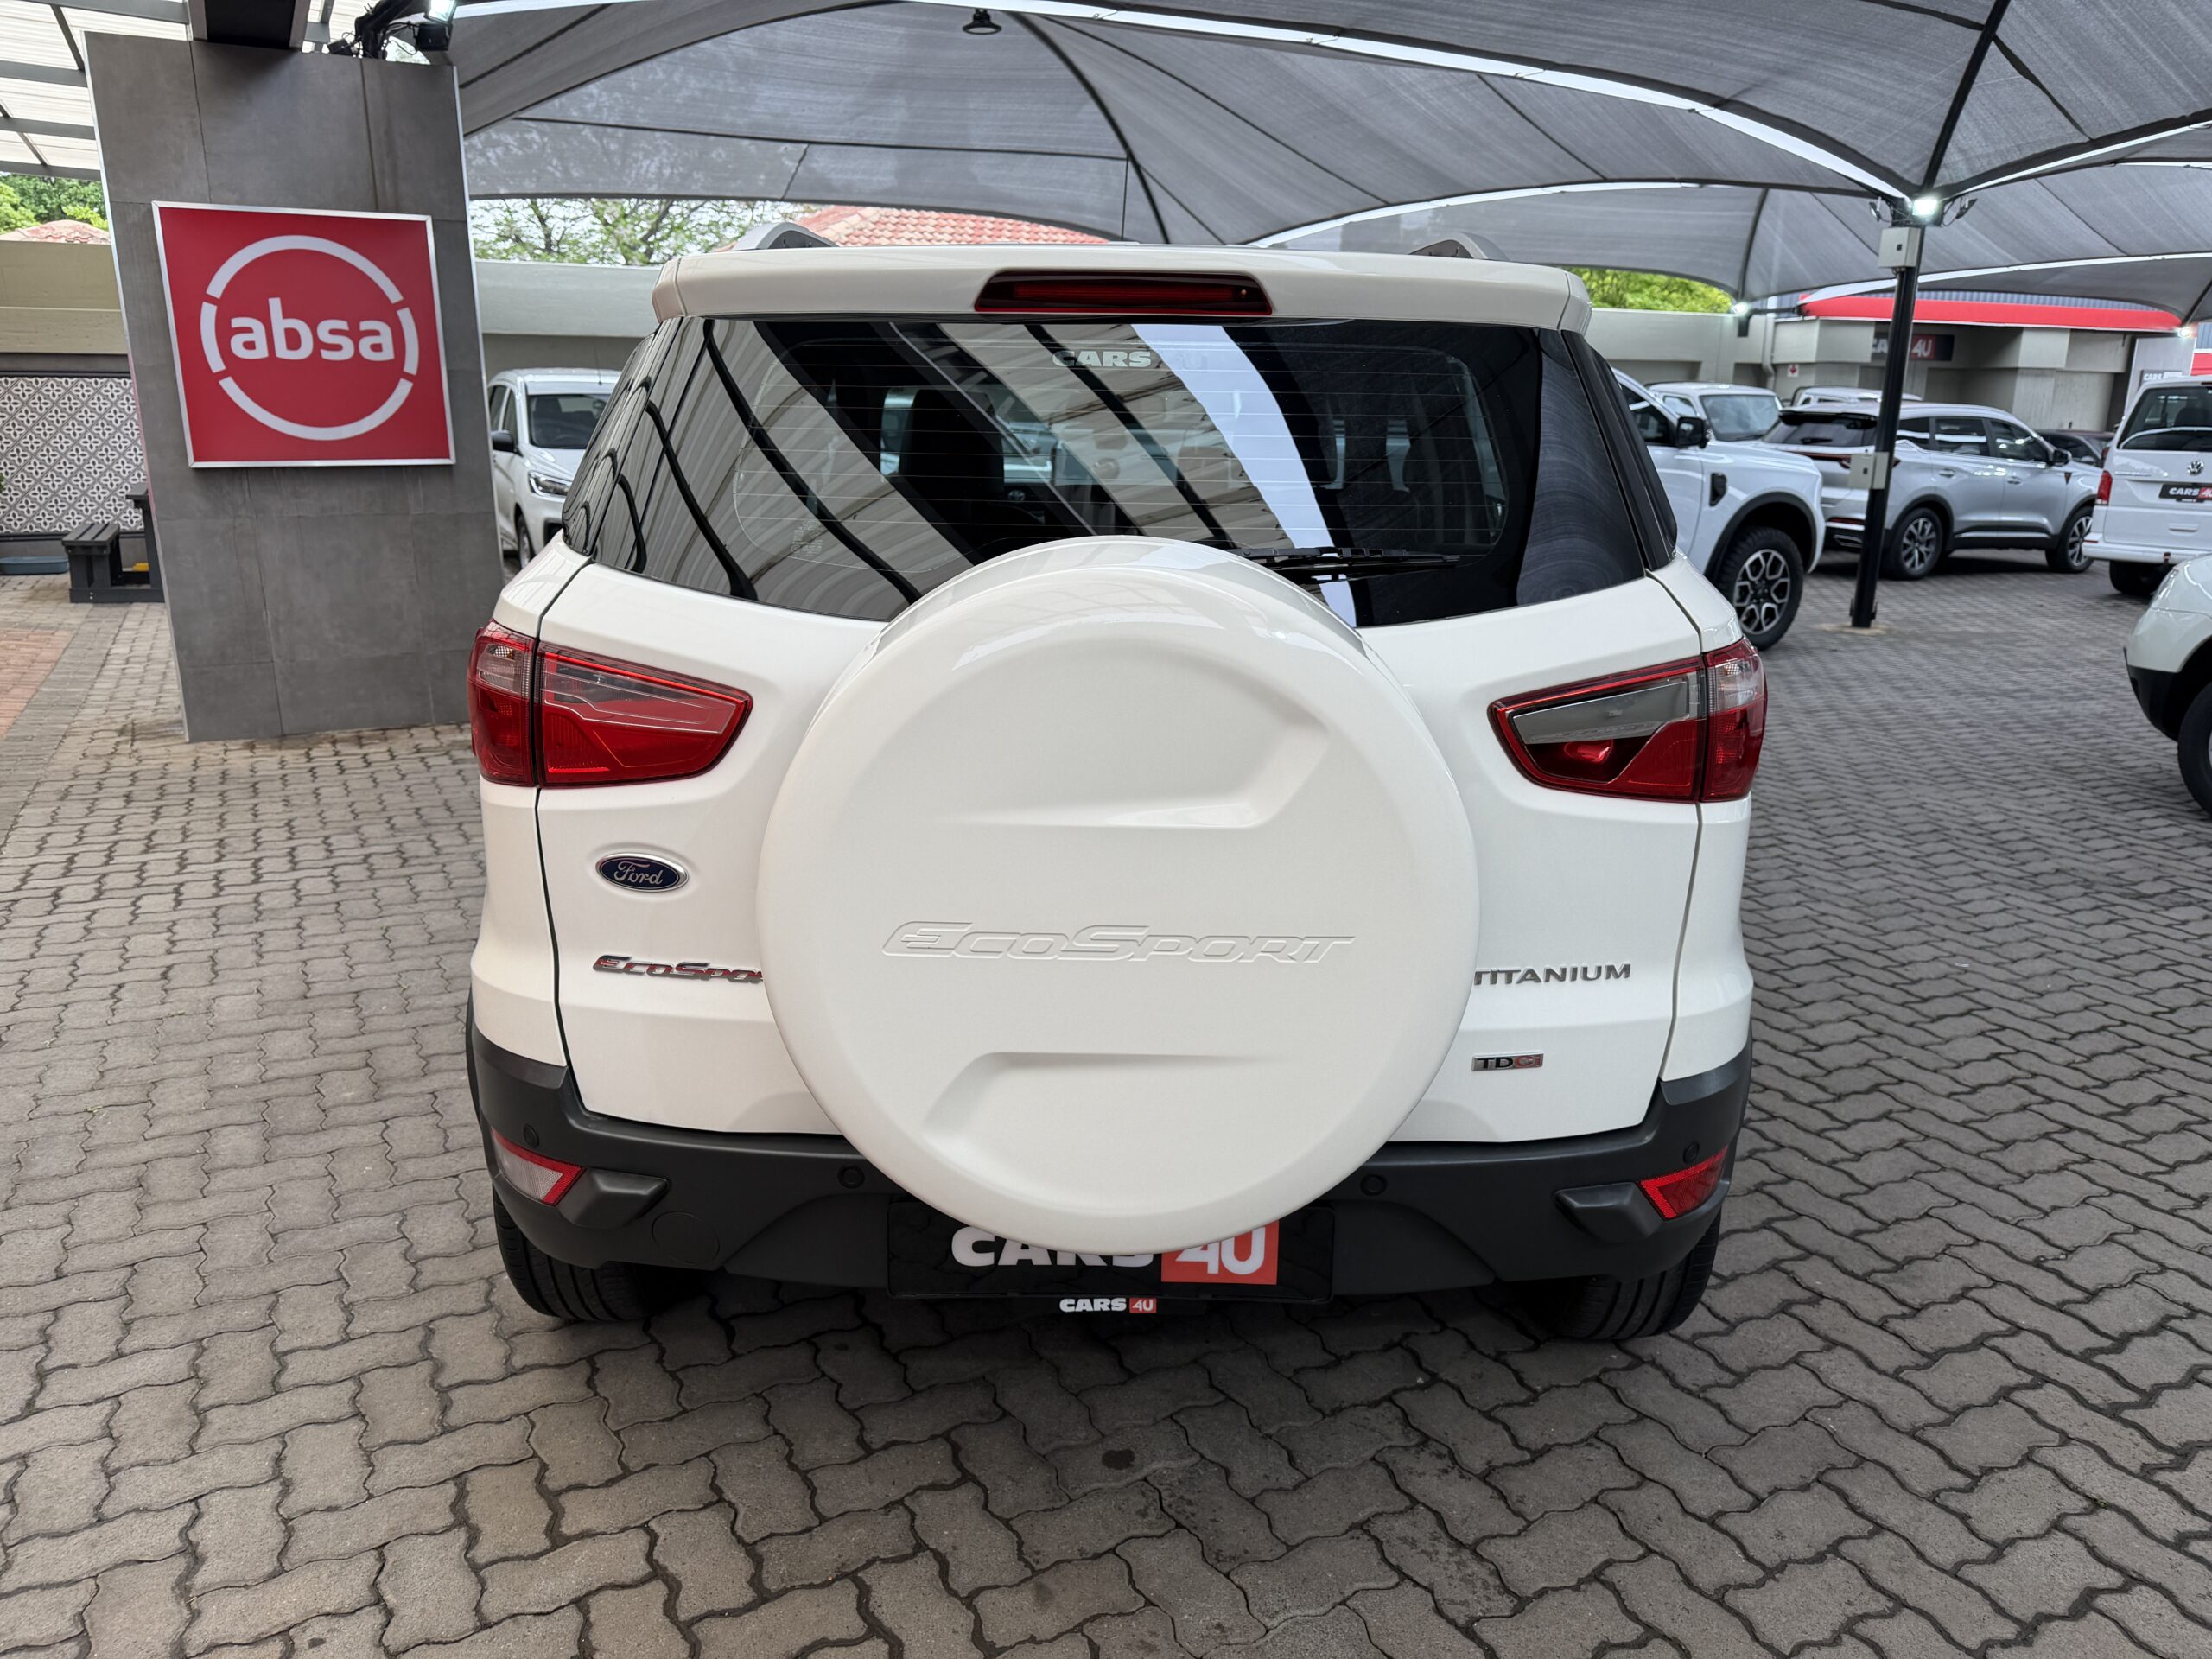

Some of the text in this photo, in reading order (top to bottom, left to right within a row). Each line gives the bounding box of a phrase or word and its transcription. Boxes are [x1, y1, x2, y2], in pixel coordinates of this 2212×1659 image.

[230, 297, 395, 361] absa
[1911, 339, 1932, 357] 4U
[1052, 350, 1151, 367] CARS
[2169, 487, 2199, 496] CARS
[613, 861, 663, 885] Ford
[1474, 963, 1631, 986] TITANIUM
[1477, 1055, 1541, 1069] TDCi
[1175, 1227, 1265, 1275] 4U
[1059, 1298, 1154, 1312] CARS 4U
